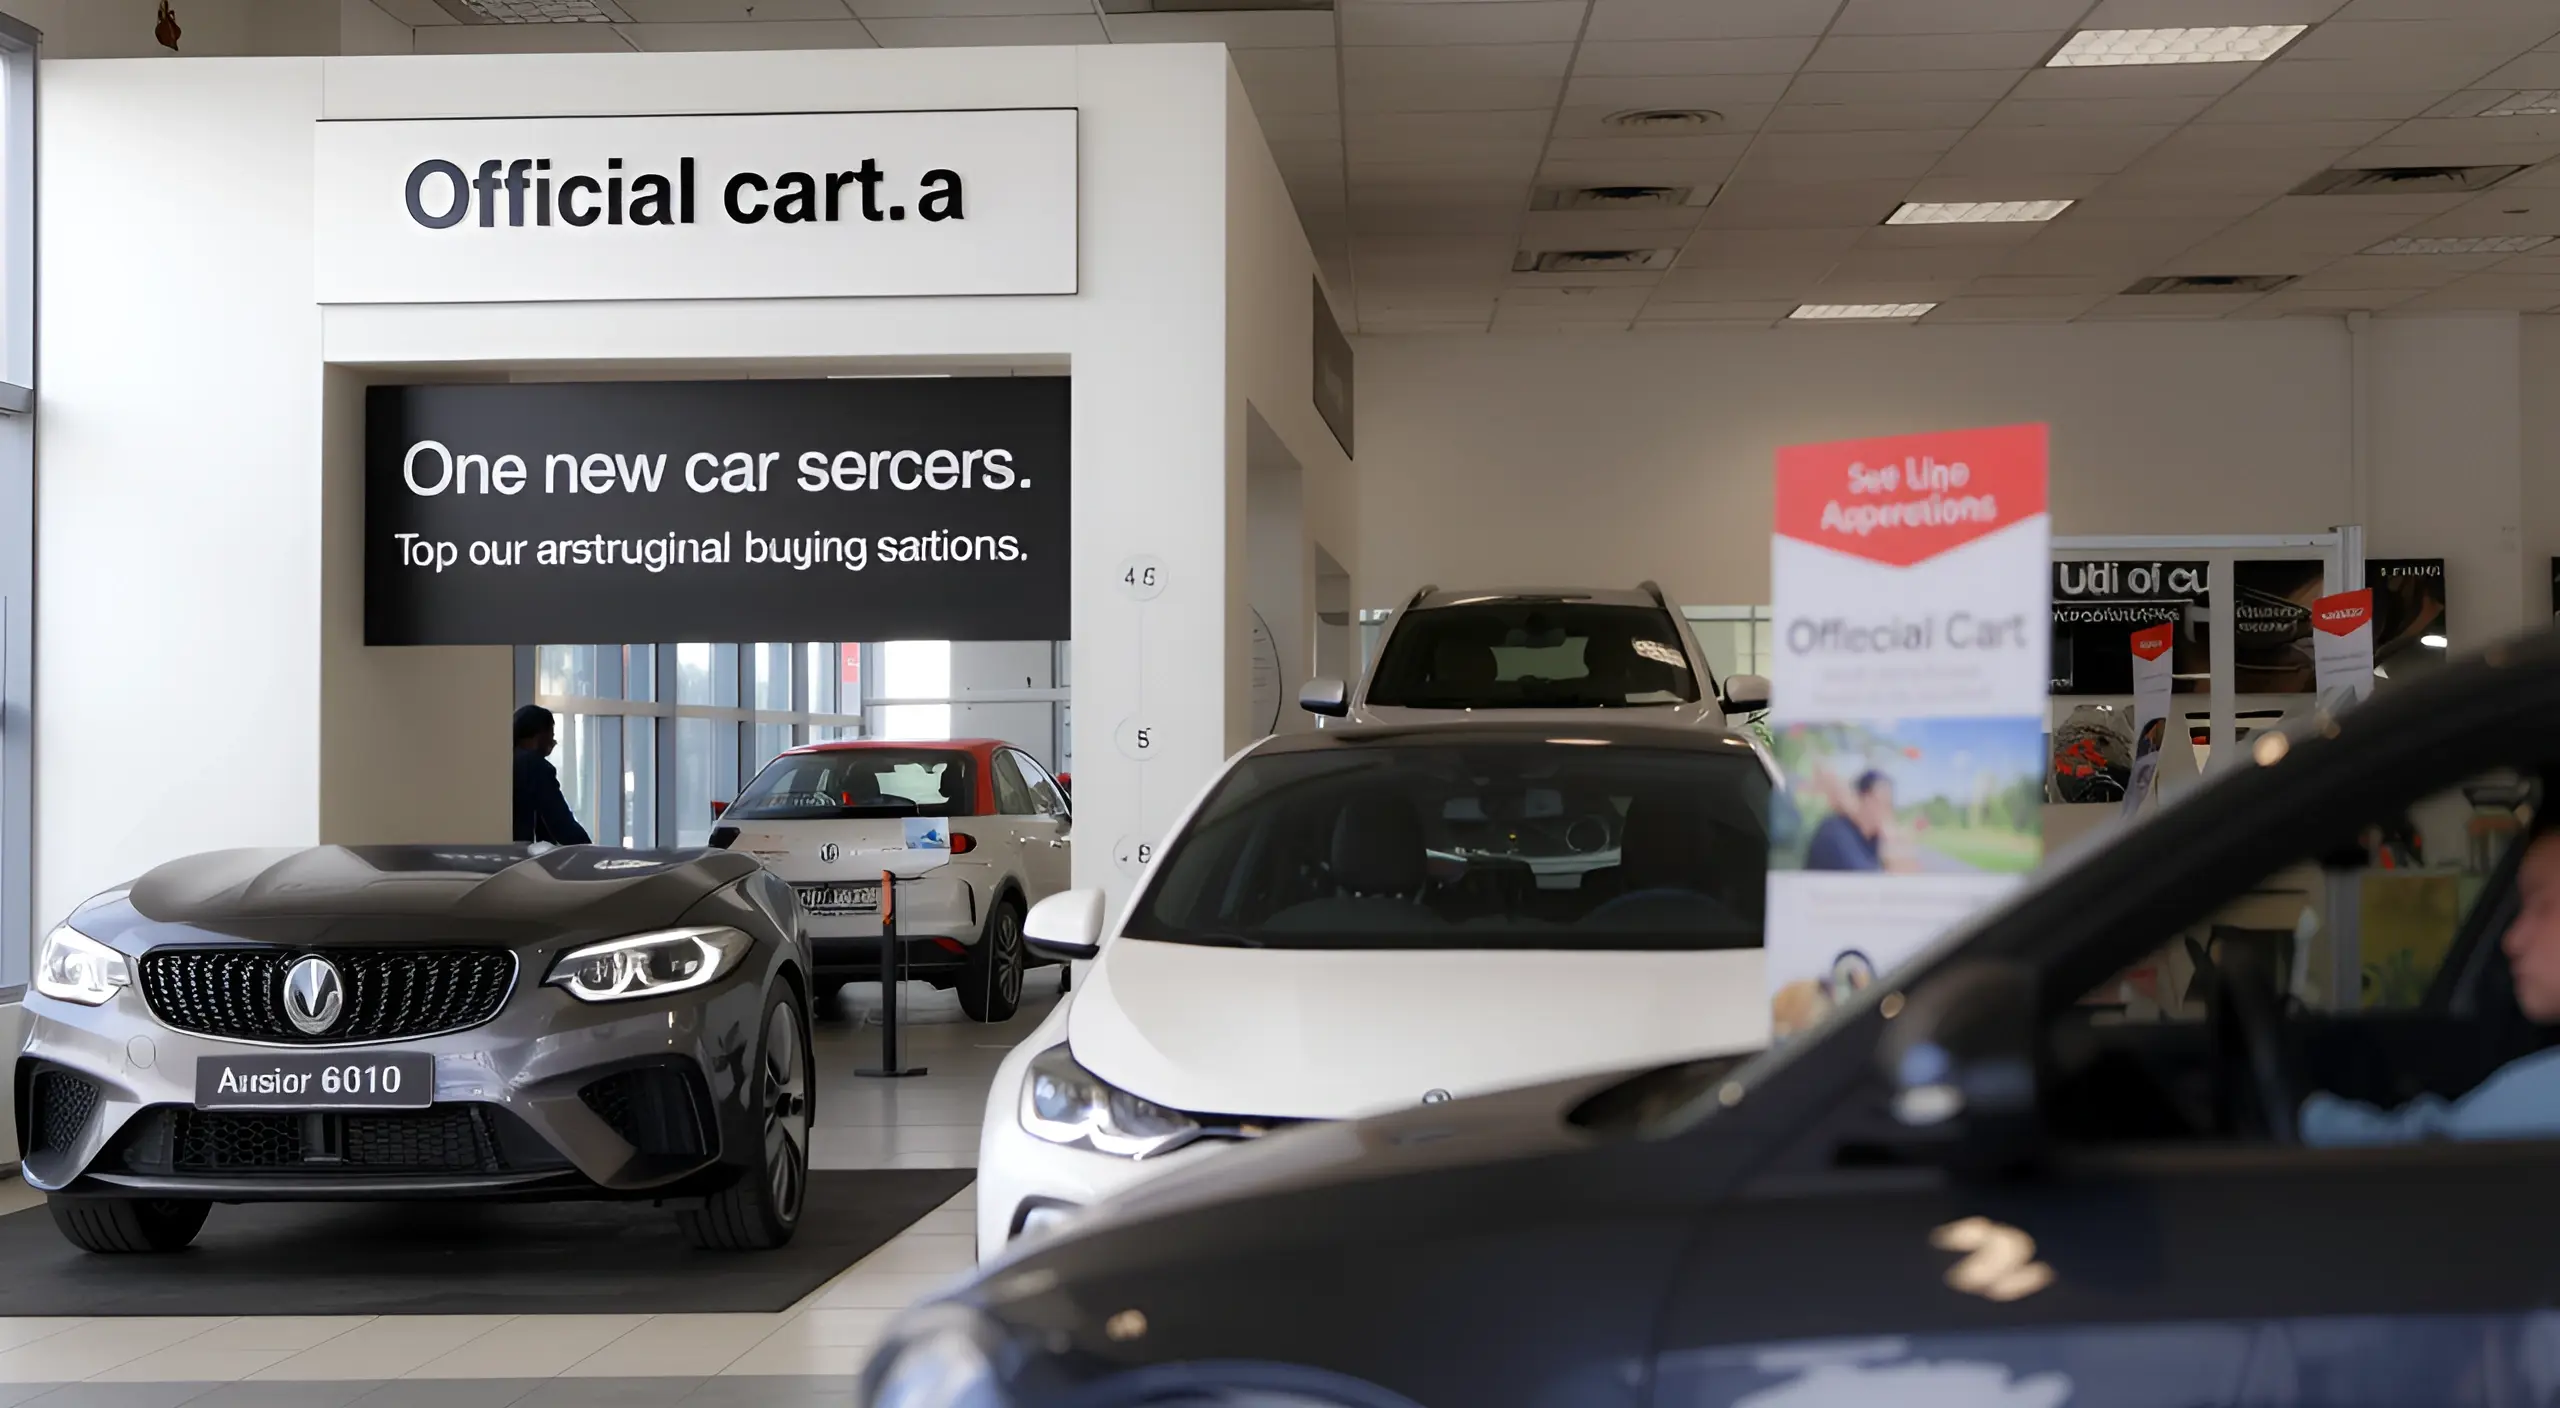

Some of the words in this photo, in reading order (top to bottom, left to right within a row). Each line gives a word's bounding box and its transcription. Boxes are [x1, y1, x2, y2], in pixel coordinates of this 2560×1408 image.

[404, 156, 695, 229] Official
[403, 439, 528, 497] One
[545, 452, 668, 494] new
[685, 451, 780, 493] car
[796, 448, 1031, 491] sercers.
[394, 532, 457, 573] Top
[469, 540, 529, 566] our
[745, 530, 868, 572] buying
[1945, 610, 2029, 651] Cart
[321, 1065, 401, 1093] 6010
